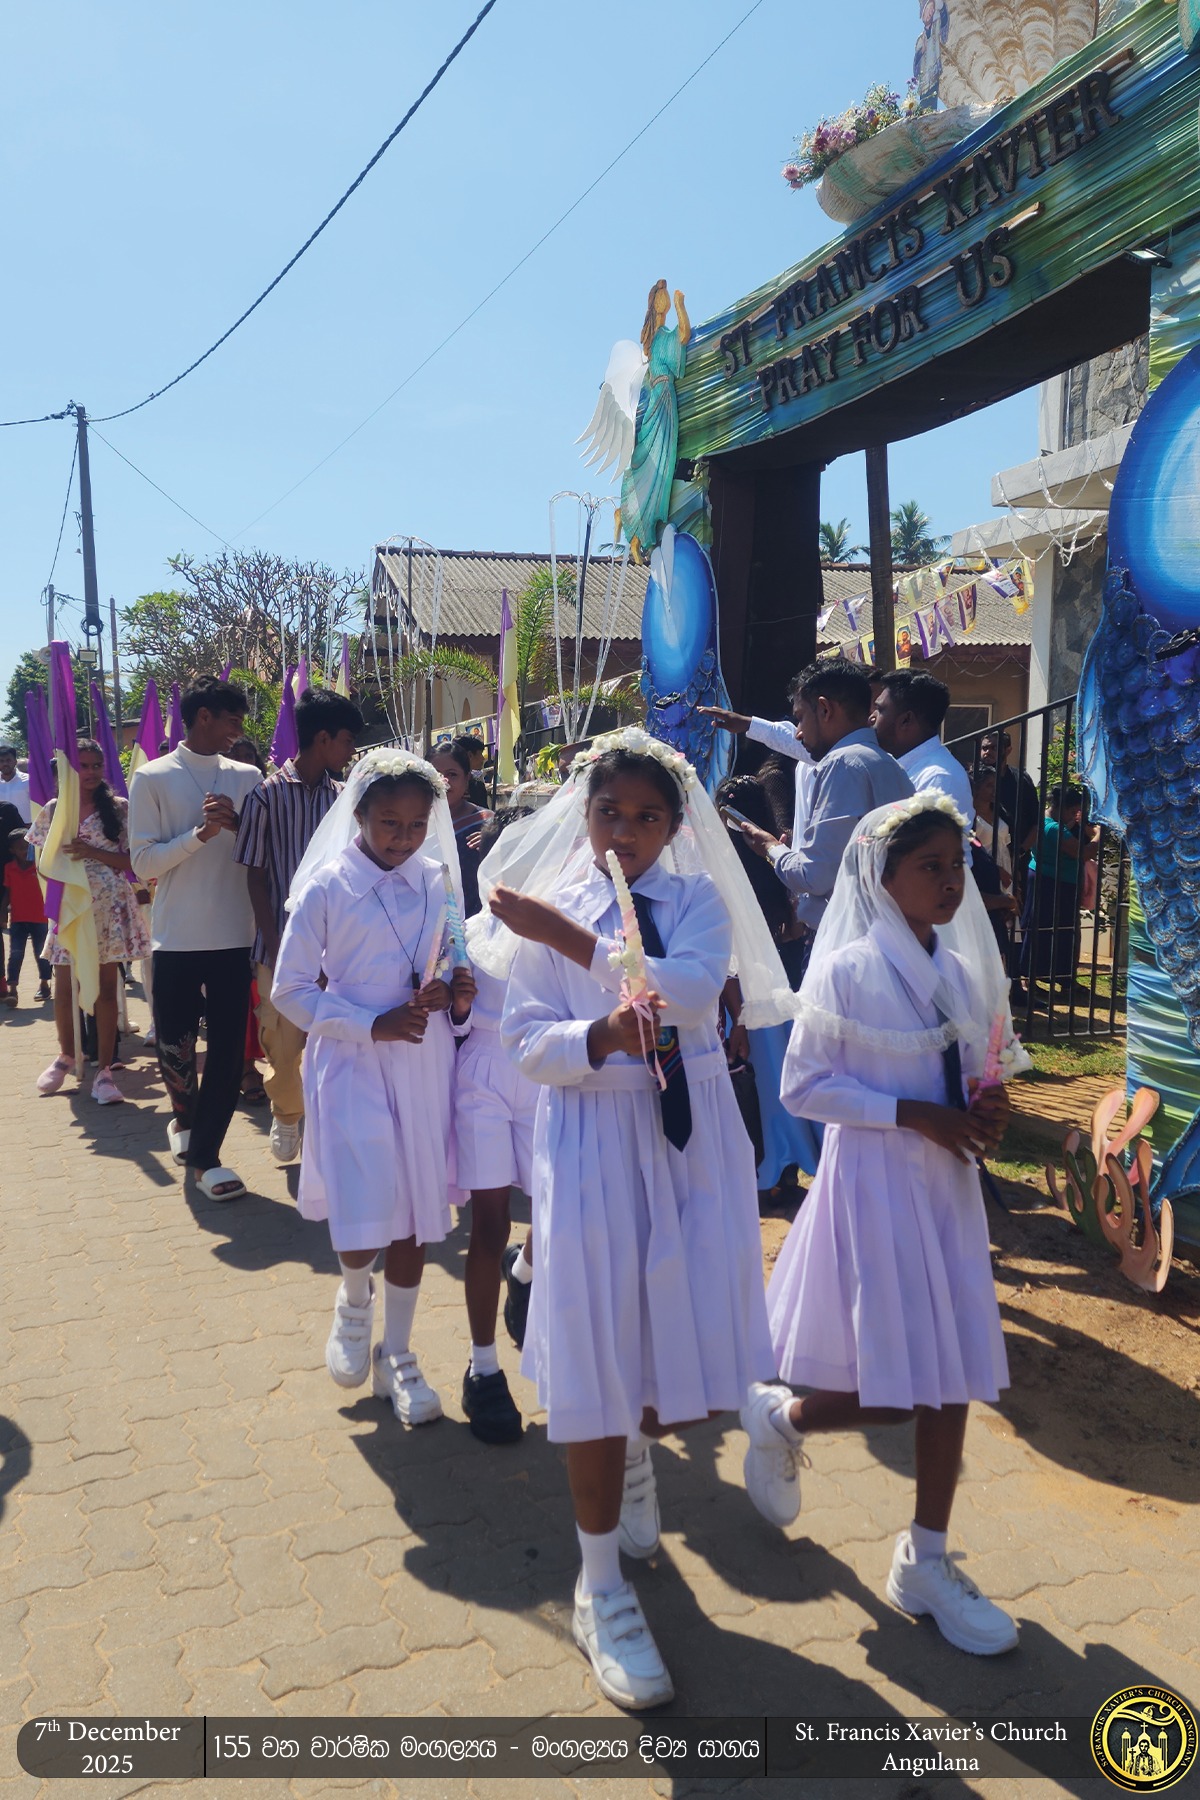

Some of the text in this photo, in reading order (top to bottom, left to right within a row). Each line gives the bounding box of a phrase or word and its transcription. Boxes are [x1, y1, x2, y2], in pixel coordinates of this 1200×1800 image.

[720, 70, 1122, 380] ST FRANCIS XAVIER
[757, 227, 1013, 412] PRAY FOR US
